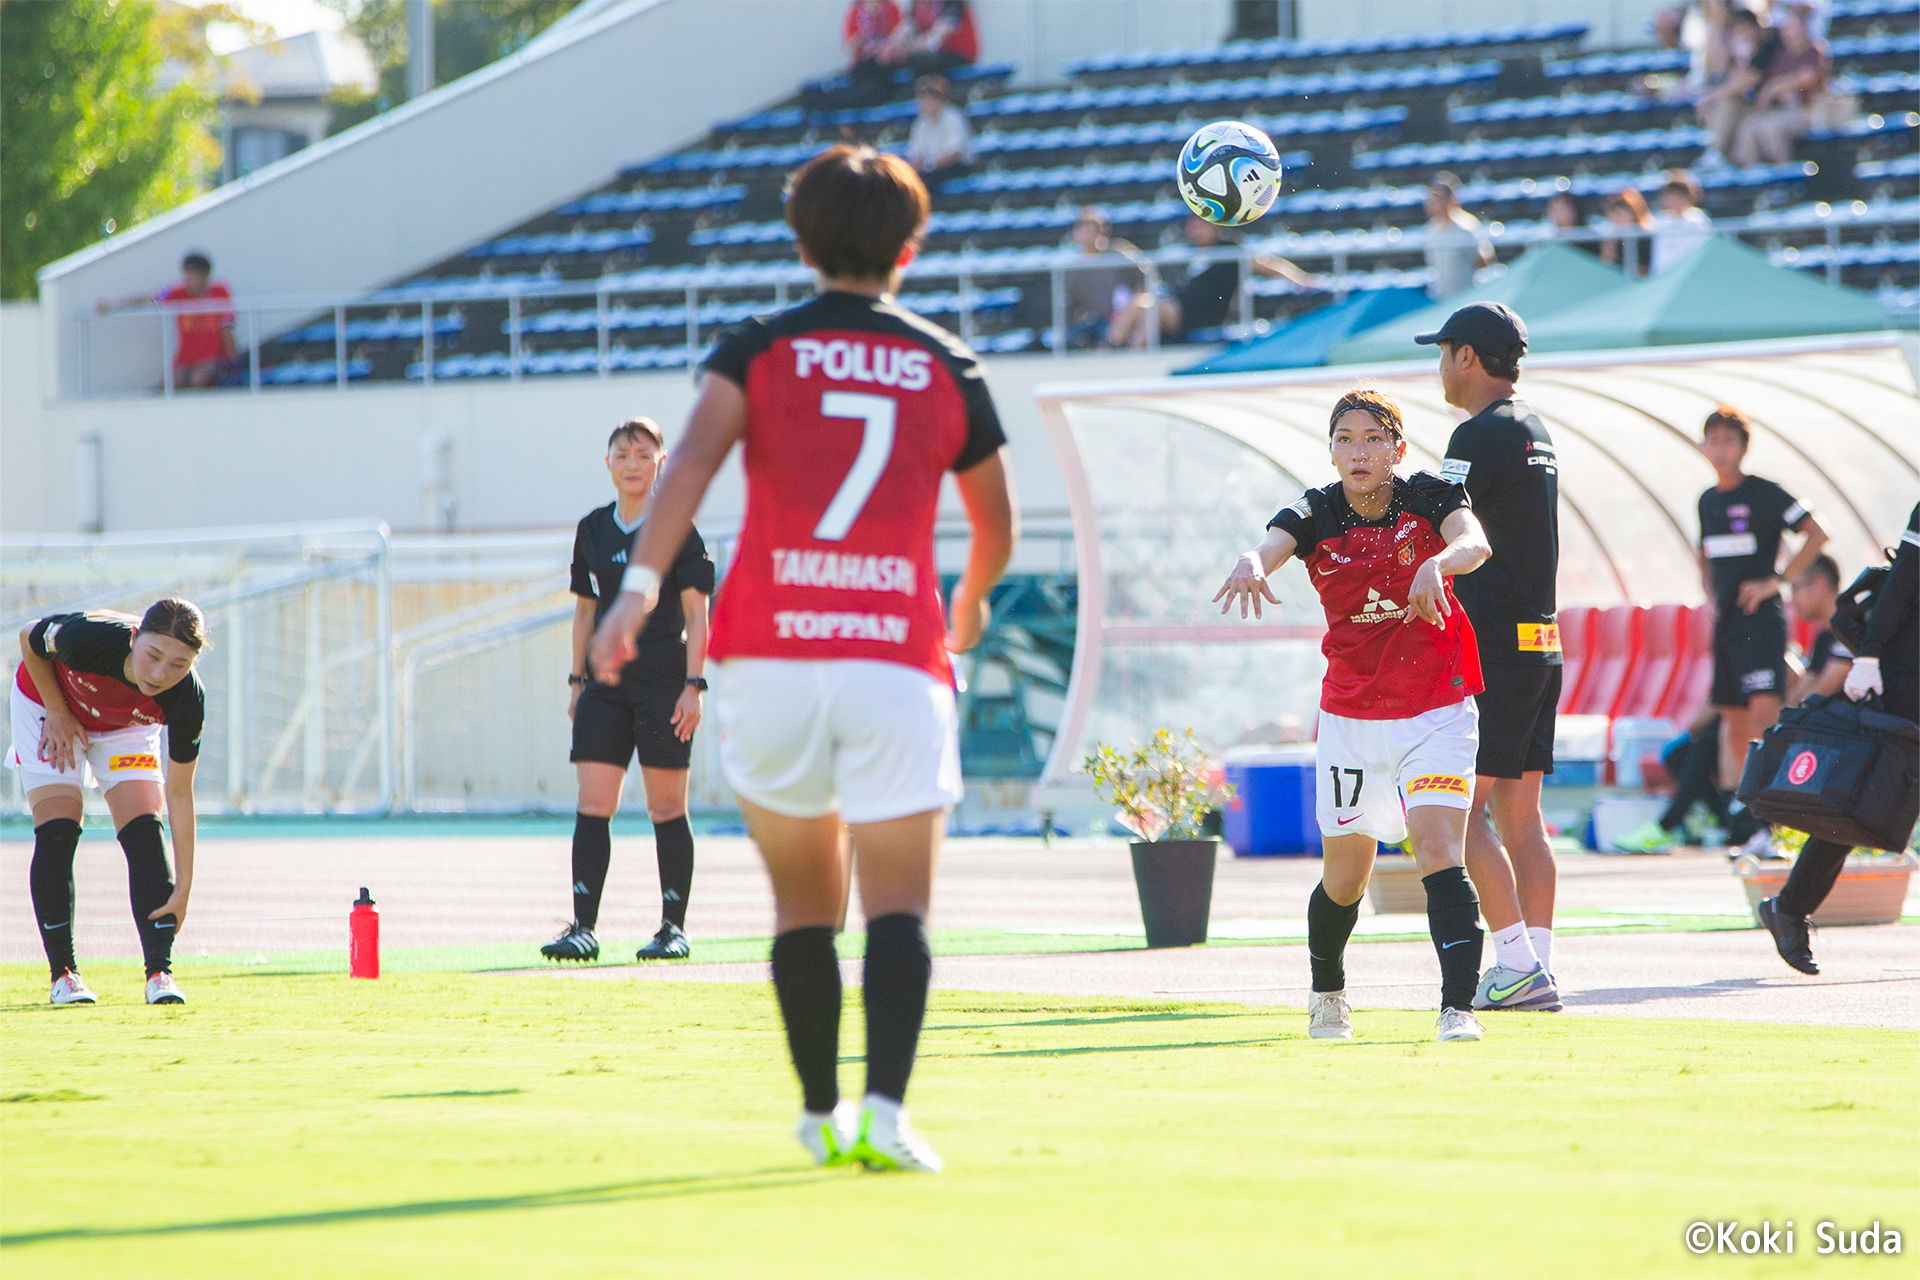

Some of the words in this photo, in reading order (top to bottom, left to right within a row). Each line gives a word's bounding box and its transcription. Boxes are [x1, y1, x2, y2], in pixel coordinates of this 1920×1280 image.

[790, 338, 933, 392] POLUS
[813, 390, 897, 540] 7
[773, 610, 909, 645] TOPPAN
[1329, 765, 1364, 808] 17
[1412, 776, 1465, 793] DHL
